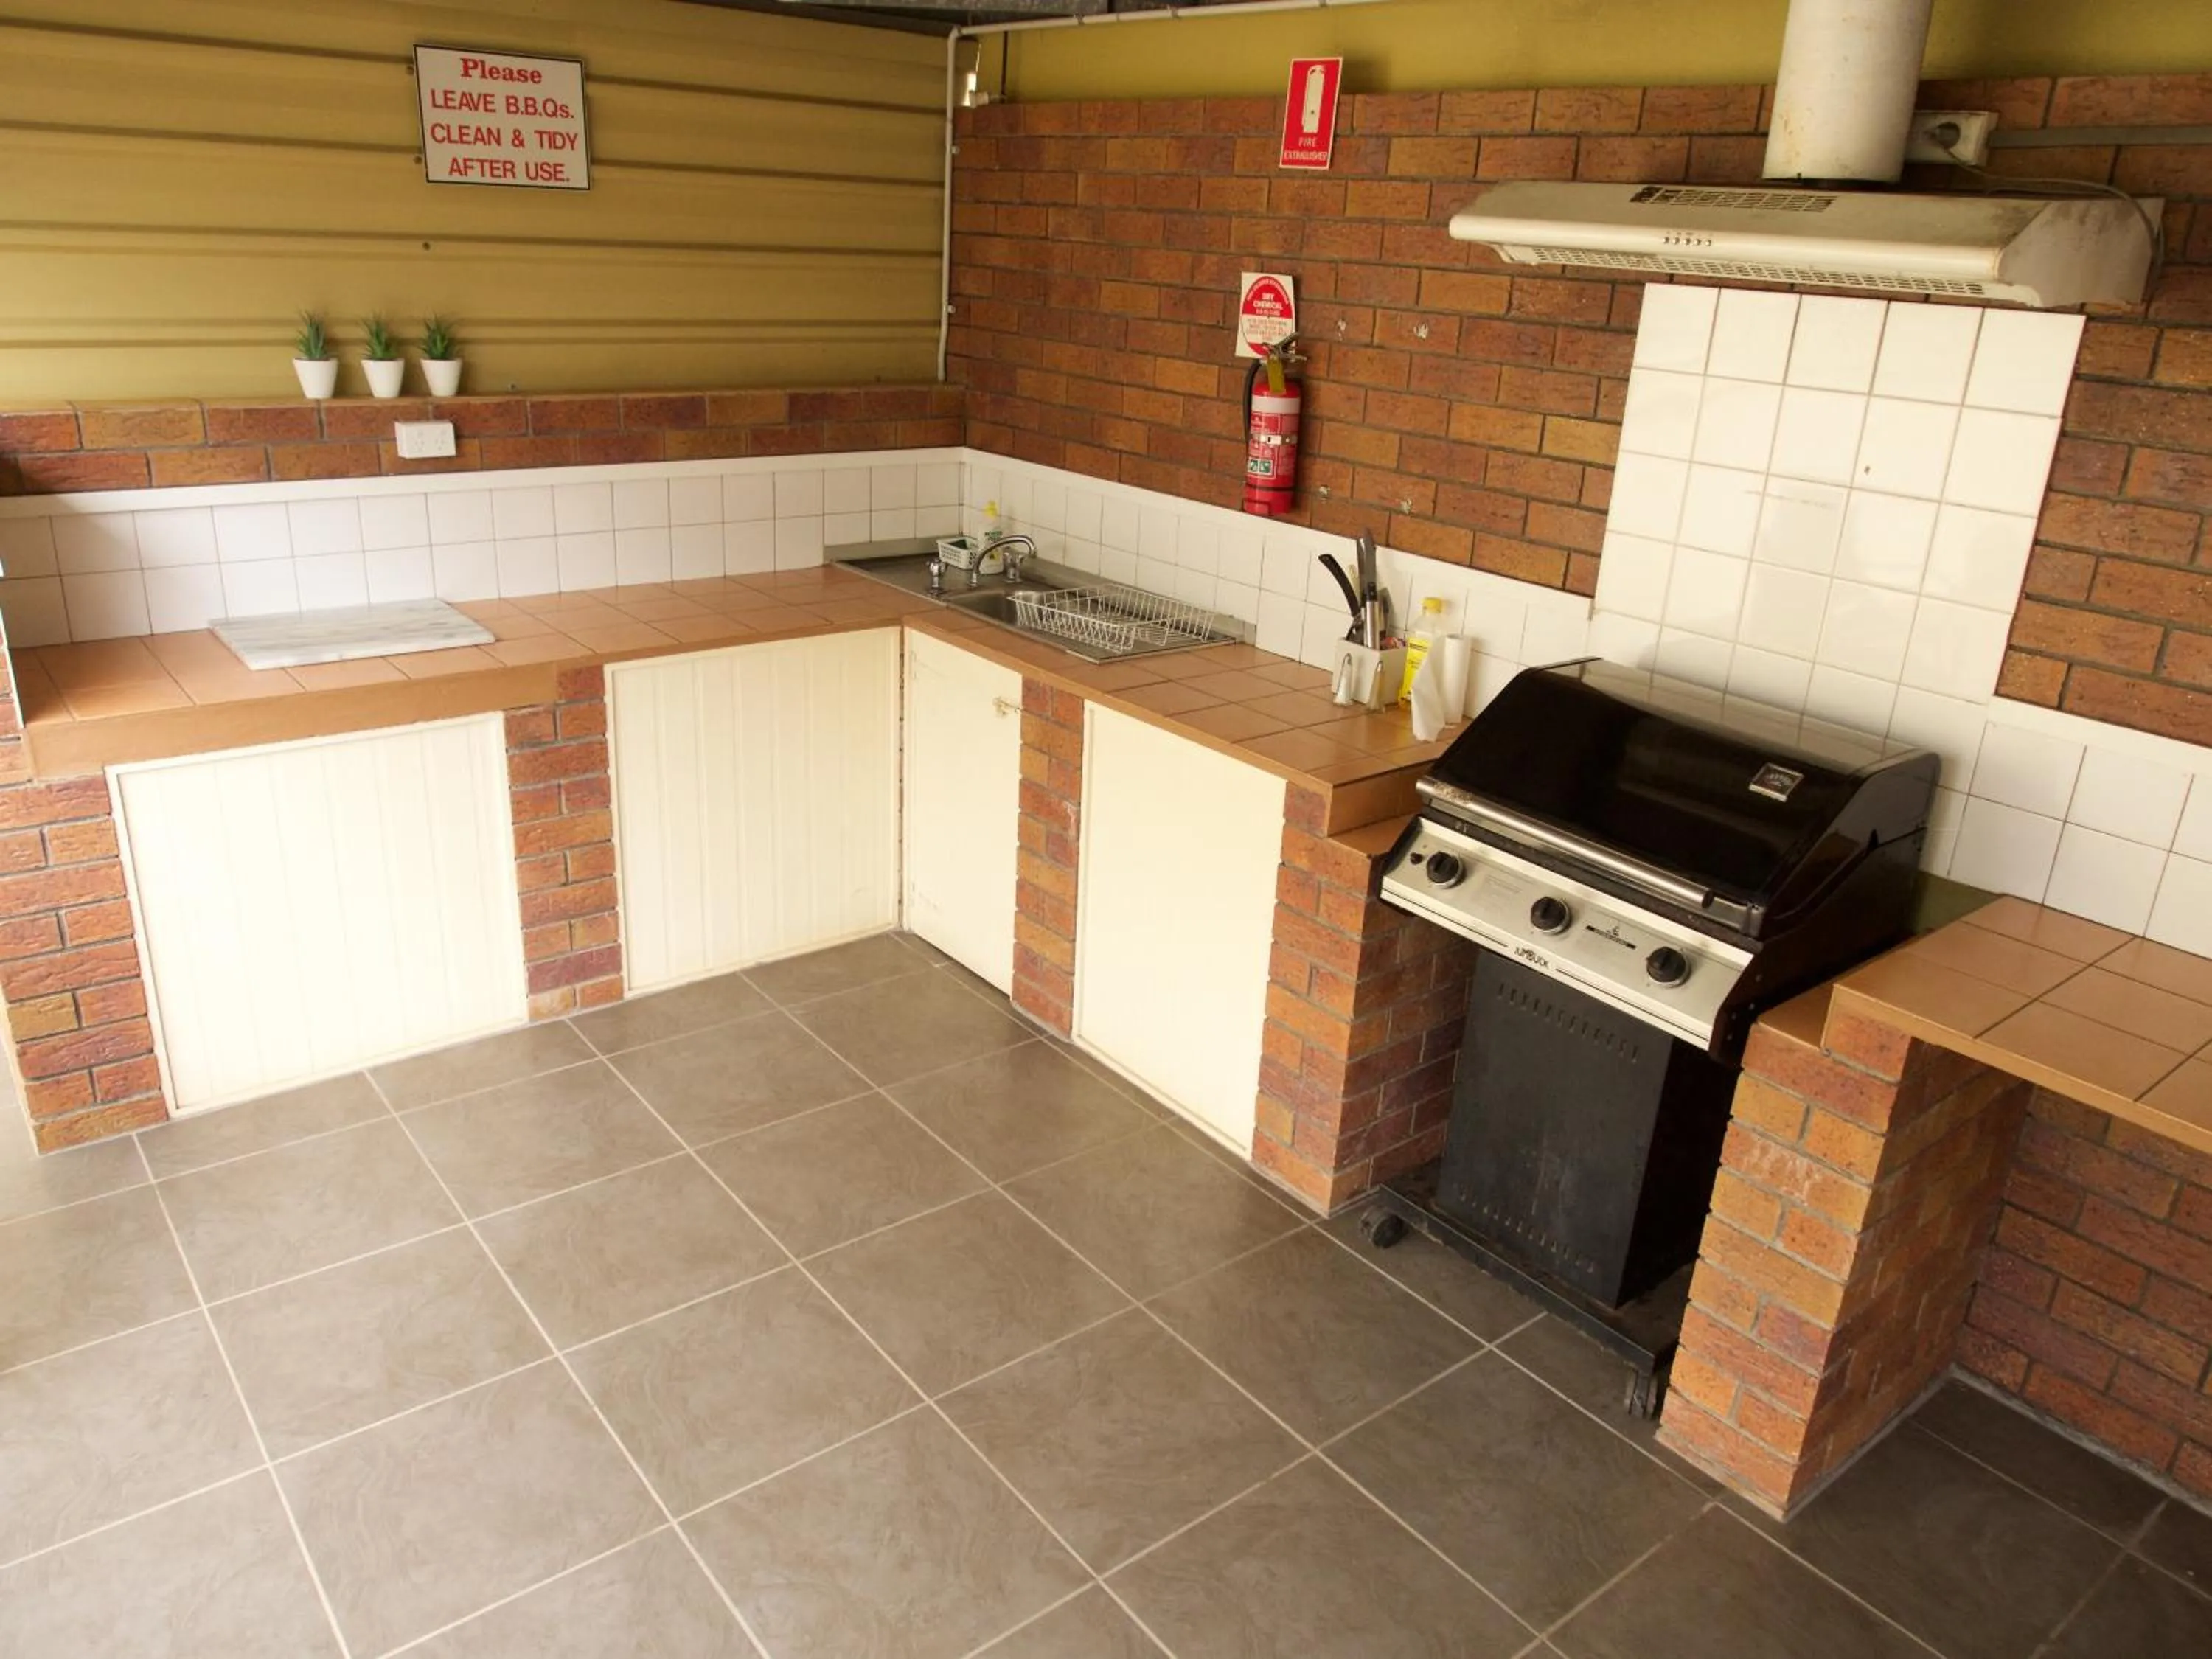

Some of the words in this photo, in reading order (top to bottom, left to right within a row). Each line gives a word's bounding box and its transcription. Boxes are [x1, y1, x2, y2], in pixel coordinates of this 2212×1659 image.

[460, 58, 542, 83] Please
[431, 88, 496, 113] LEAVE
[505, 94, 574, 119] B.B.Qs.
[431, 122, 501, 146] CLEAN
[511, 129, 525, 147] &
[534, 129, 578, 150] TIDY
[1298, 136, 1317, 147] FIRE
[1284, 150, 1328, 161] EXTINGUISHER
[448, 156, 516, 178] AFTER
[525, 161, 570, 182] USE.
[1514, 947, 1550, 970] JUMBUCK
